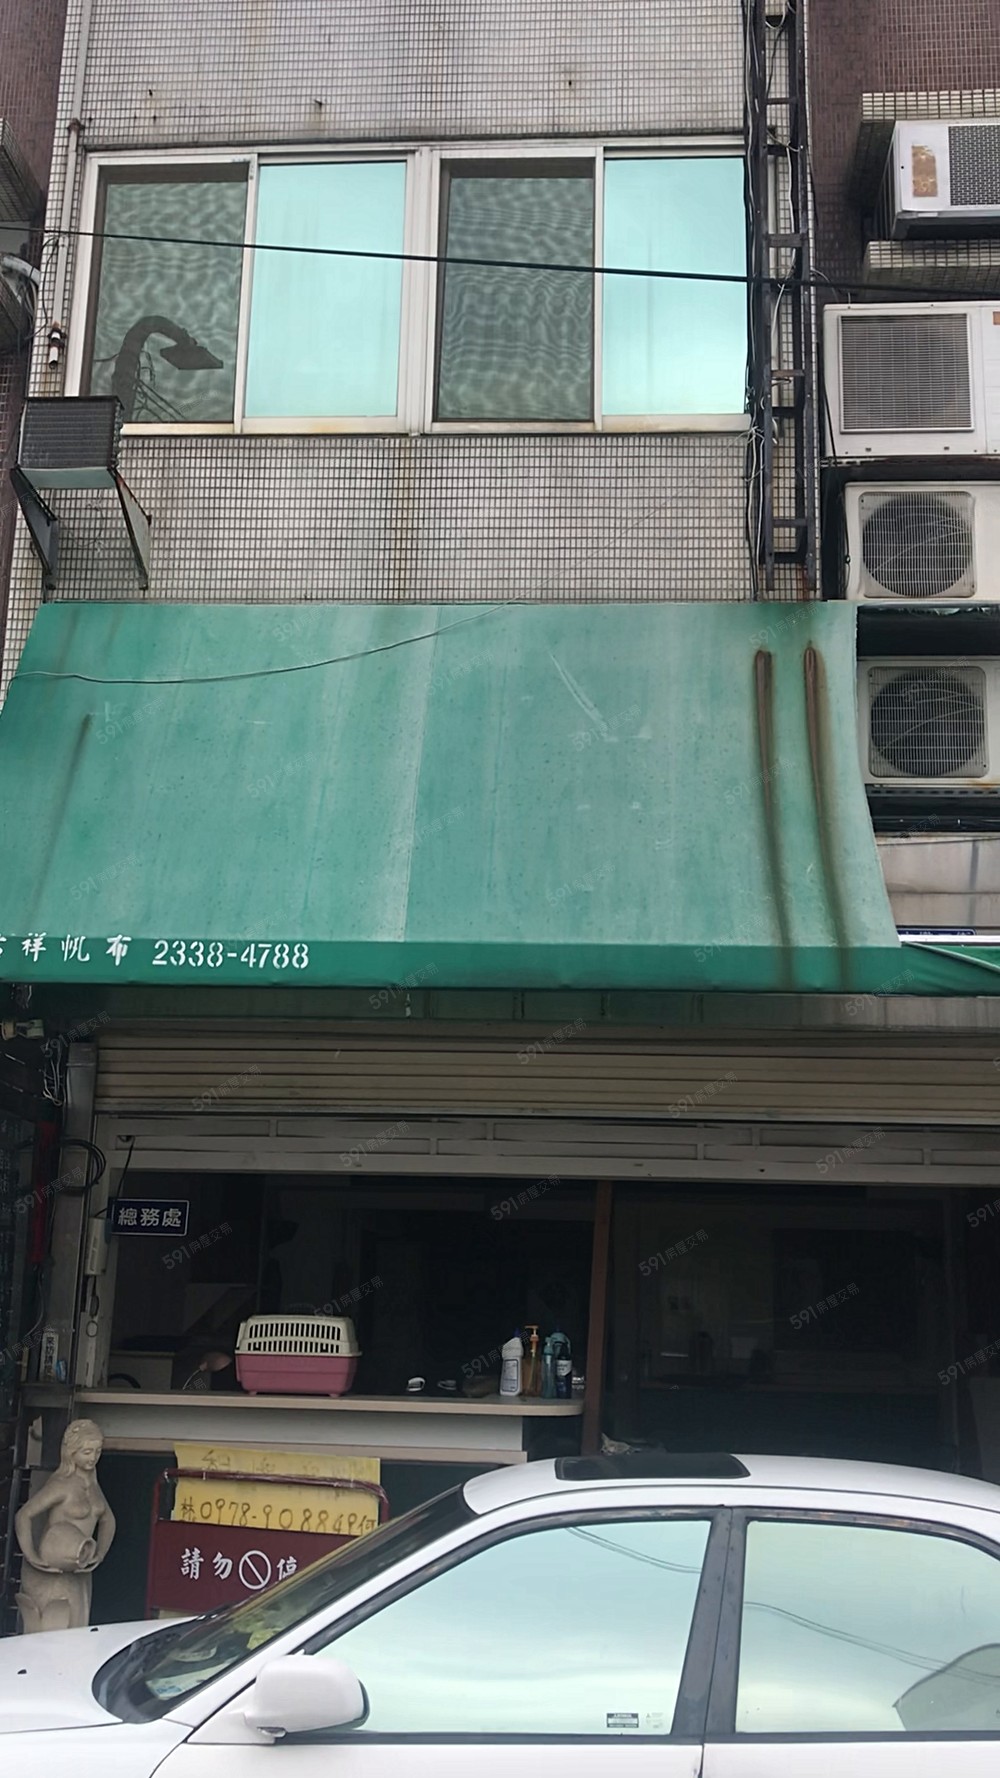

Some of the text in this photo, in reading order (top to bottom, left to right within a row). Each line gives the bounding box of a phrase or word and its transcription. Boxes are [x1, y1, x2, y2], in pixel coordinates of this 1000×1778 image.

[151, 939, 310, 970] 2338-4788
[117, 1207, 183, 1228] 總務處
[180, 1547, 233, 1581] 請勿
